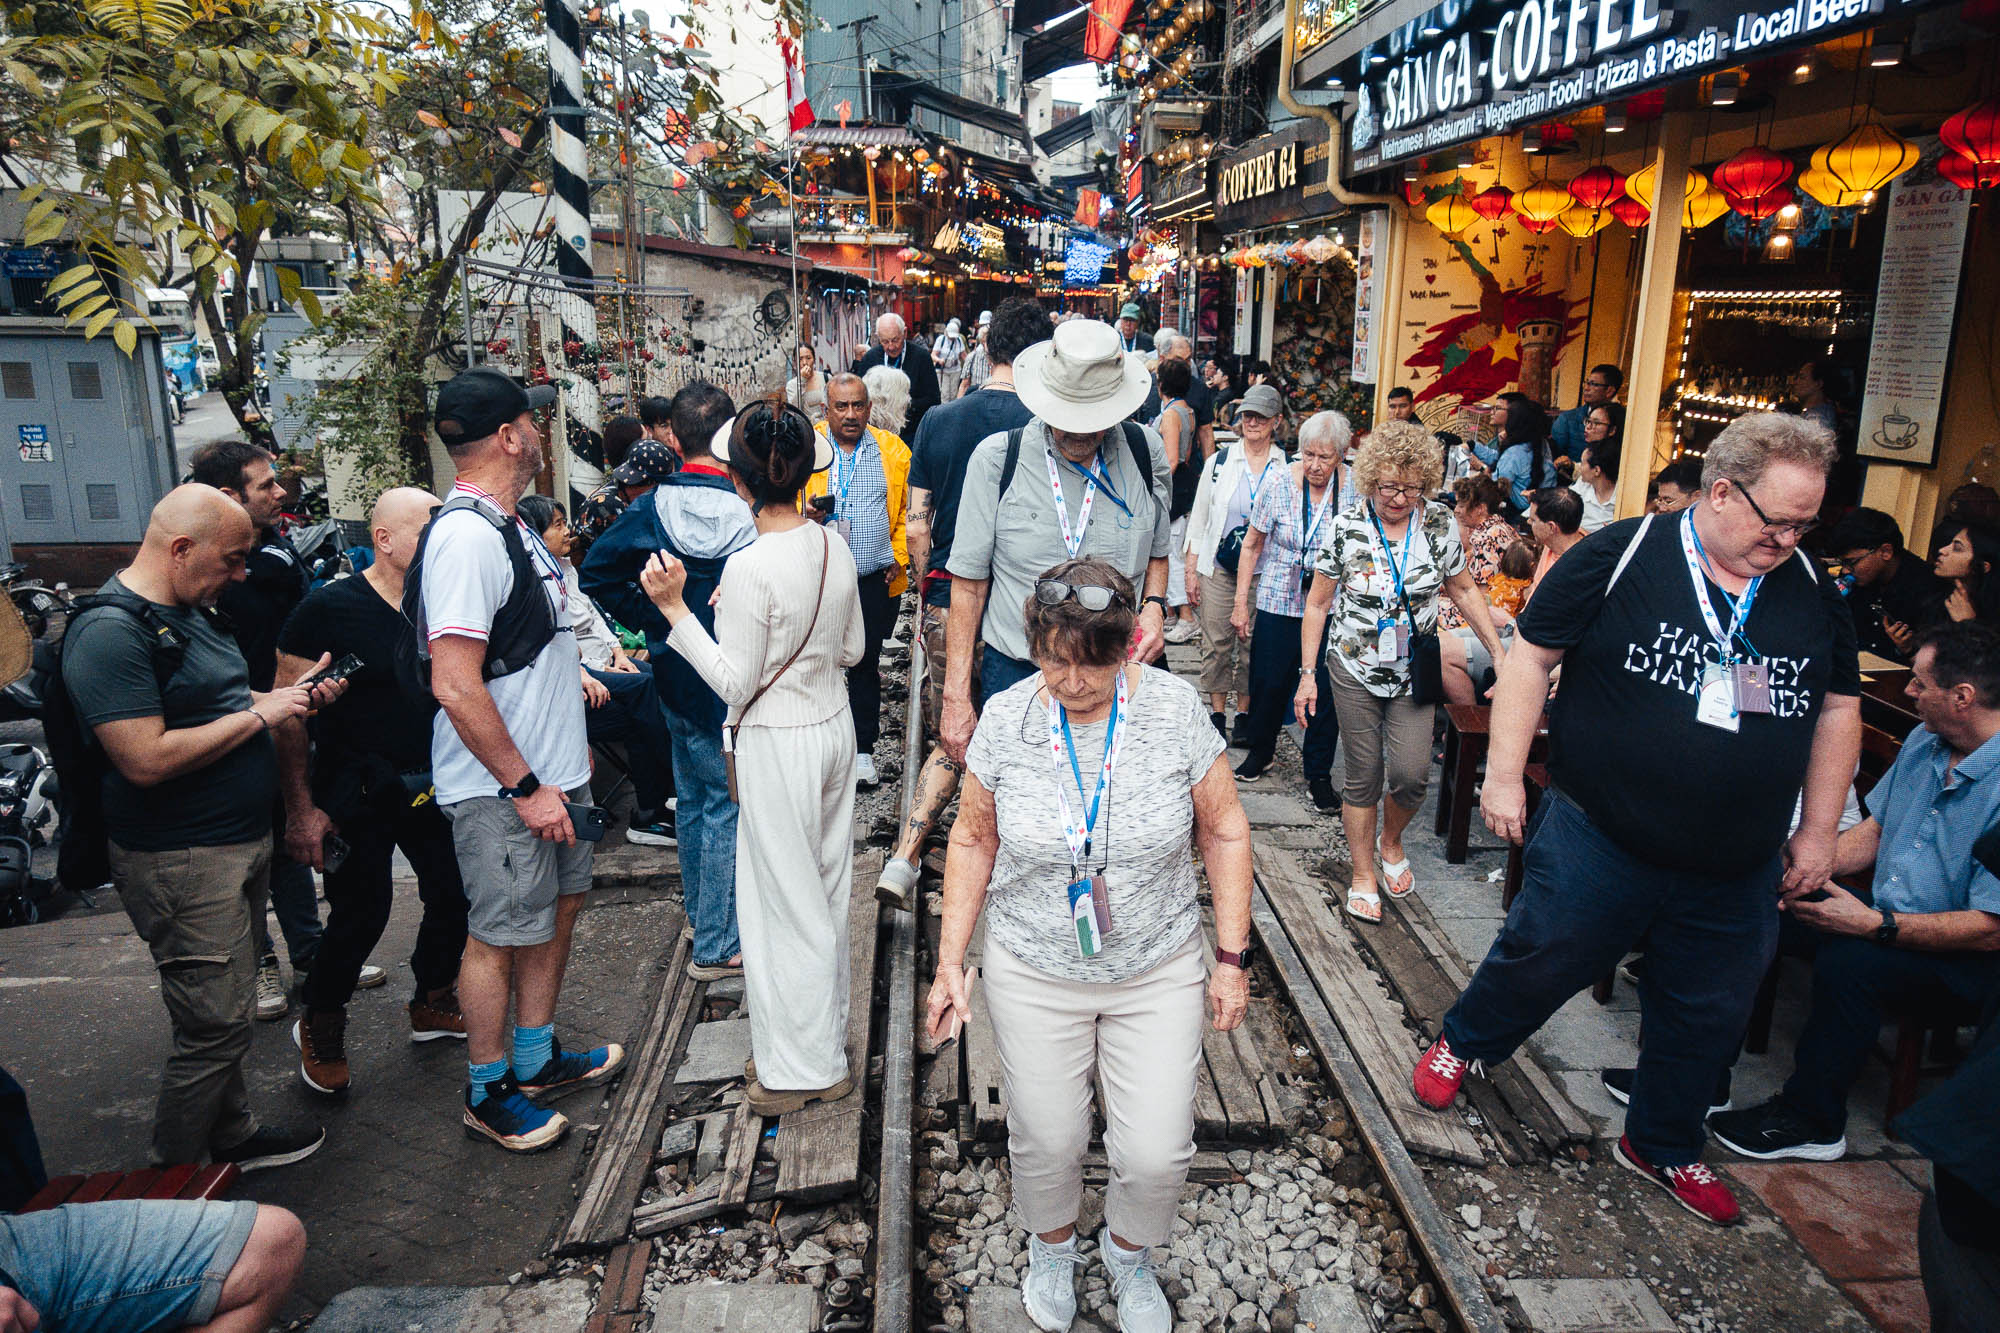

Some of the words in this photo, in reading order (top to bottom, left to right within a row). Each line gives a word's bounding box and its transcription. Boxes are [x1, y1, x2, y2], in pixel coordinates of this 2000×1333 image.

[1381, 132, 1425, 161] Vietnamese
[1426, 115, 1476, 150] Restaurant
[1485, 90, 1545, 130] Vegetarian
[1548, 76, 1584, 108] Food
[1595, 60, 1639, 95] Pizza
[1643, 45, 1657, 79] &
[1661, 31, 1717, 73] Pasta
[1735, 2, 1802, 51] Local
[1435, 31, 1472, 112] GA
[1222, 150, 1276, 206] COFFEE
[1279, 142, 1297, 190] 64
[1939, 188, 1965, 204] GA
